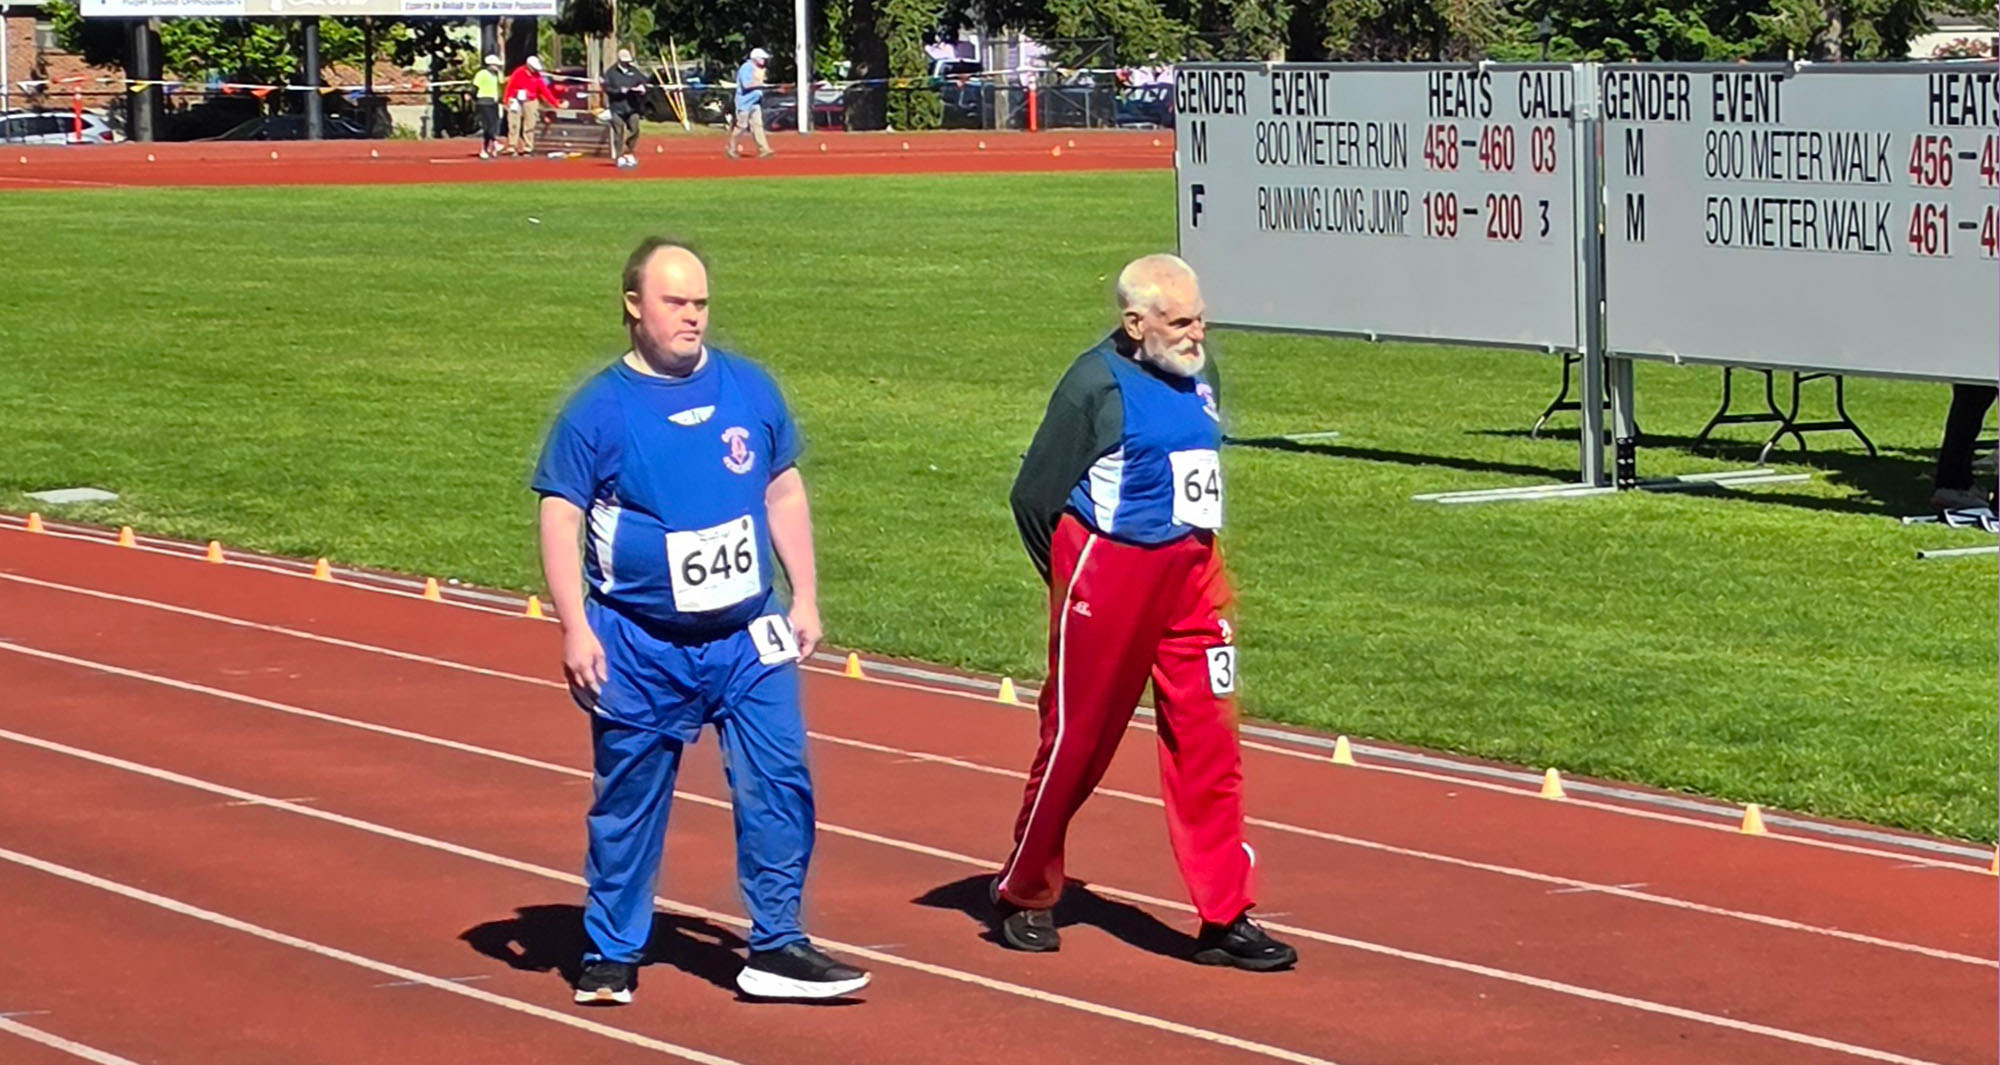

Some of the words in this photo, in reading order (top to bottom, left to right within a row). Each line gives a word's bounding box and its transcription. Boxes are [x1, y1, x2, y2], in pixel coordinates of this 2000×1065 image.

[1175, 71, 1247, 115] GENDER
[1272, 72, 1330, 117] EVENT
[1428, 71, 1493, 119] HEATS
[1518, 72, 1572, 119] CALL
[1604, 72, 1691, 122] GENDER
[1713, 74, 1785, 123] EVENT
[1191, 120, 1207, 164] M
[1256, 121, 1290, 165] 800
[1296, 121, 1361, 166] METER
[1366, 122, 1408, 168] RUN
[1531, 125, 1557, 173] 03
[1625, 128, 1644, 176] M
[1705, 130, 1744, 178] 800
[1751, 130, 1823, 181] METER
[1828, 132, 1892, 183] WALK
[1191, 184, 1205, 227] F
[1258, 186, 1322, 231] RUNNING
[1325, 187, 1365, 232] LONG
[1368, 188, 1410, 233] JUMP
[1539, 200, 1550, 237] 3
[1626, 193, 1645, 242] M
[1705, 197, 1734, 245] 50
[1740, 197, 1818, 249] METER
[1823, 200, 1892, 252] WALK
[682, 537, 753, 586] 646
[766, 619, 786, 652] 4
[1214, 650, 1231, 688] 3
